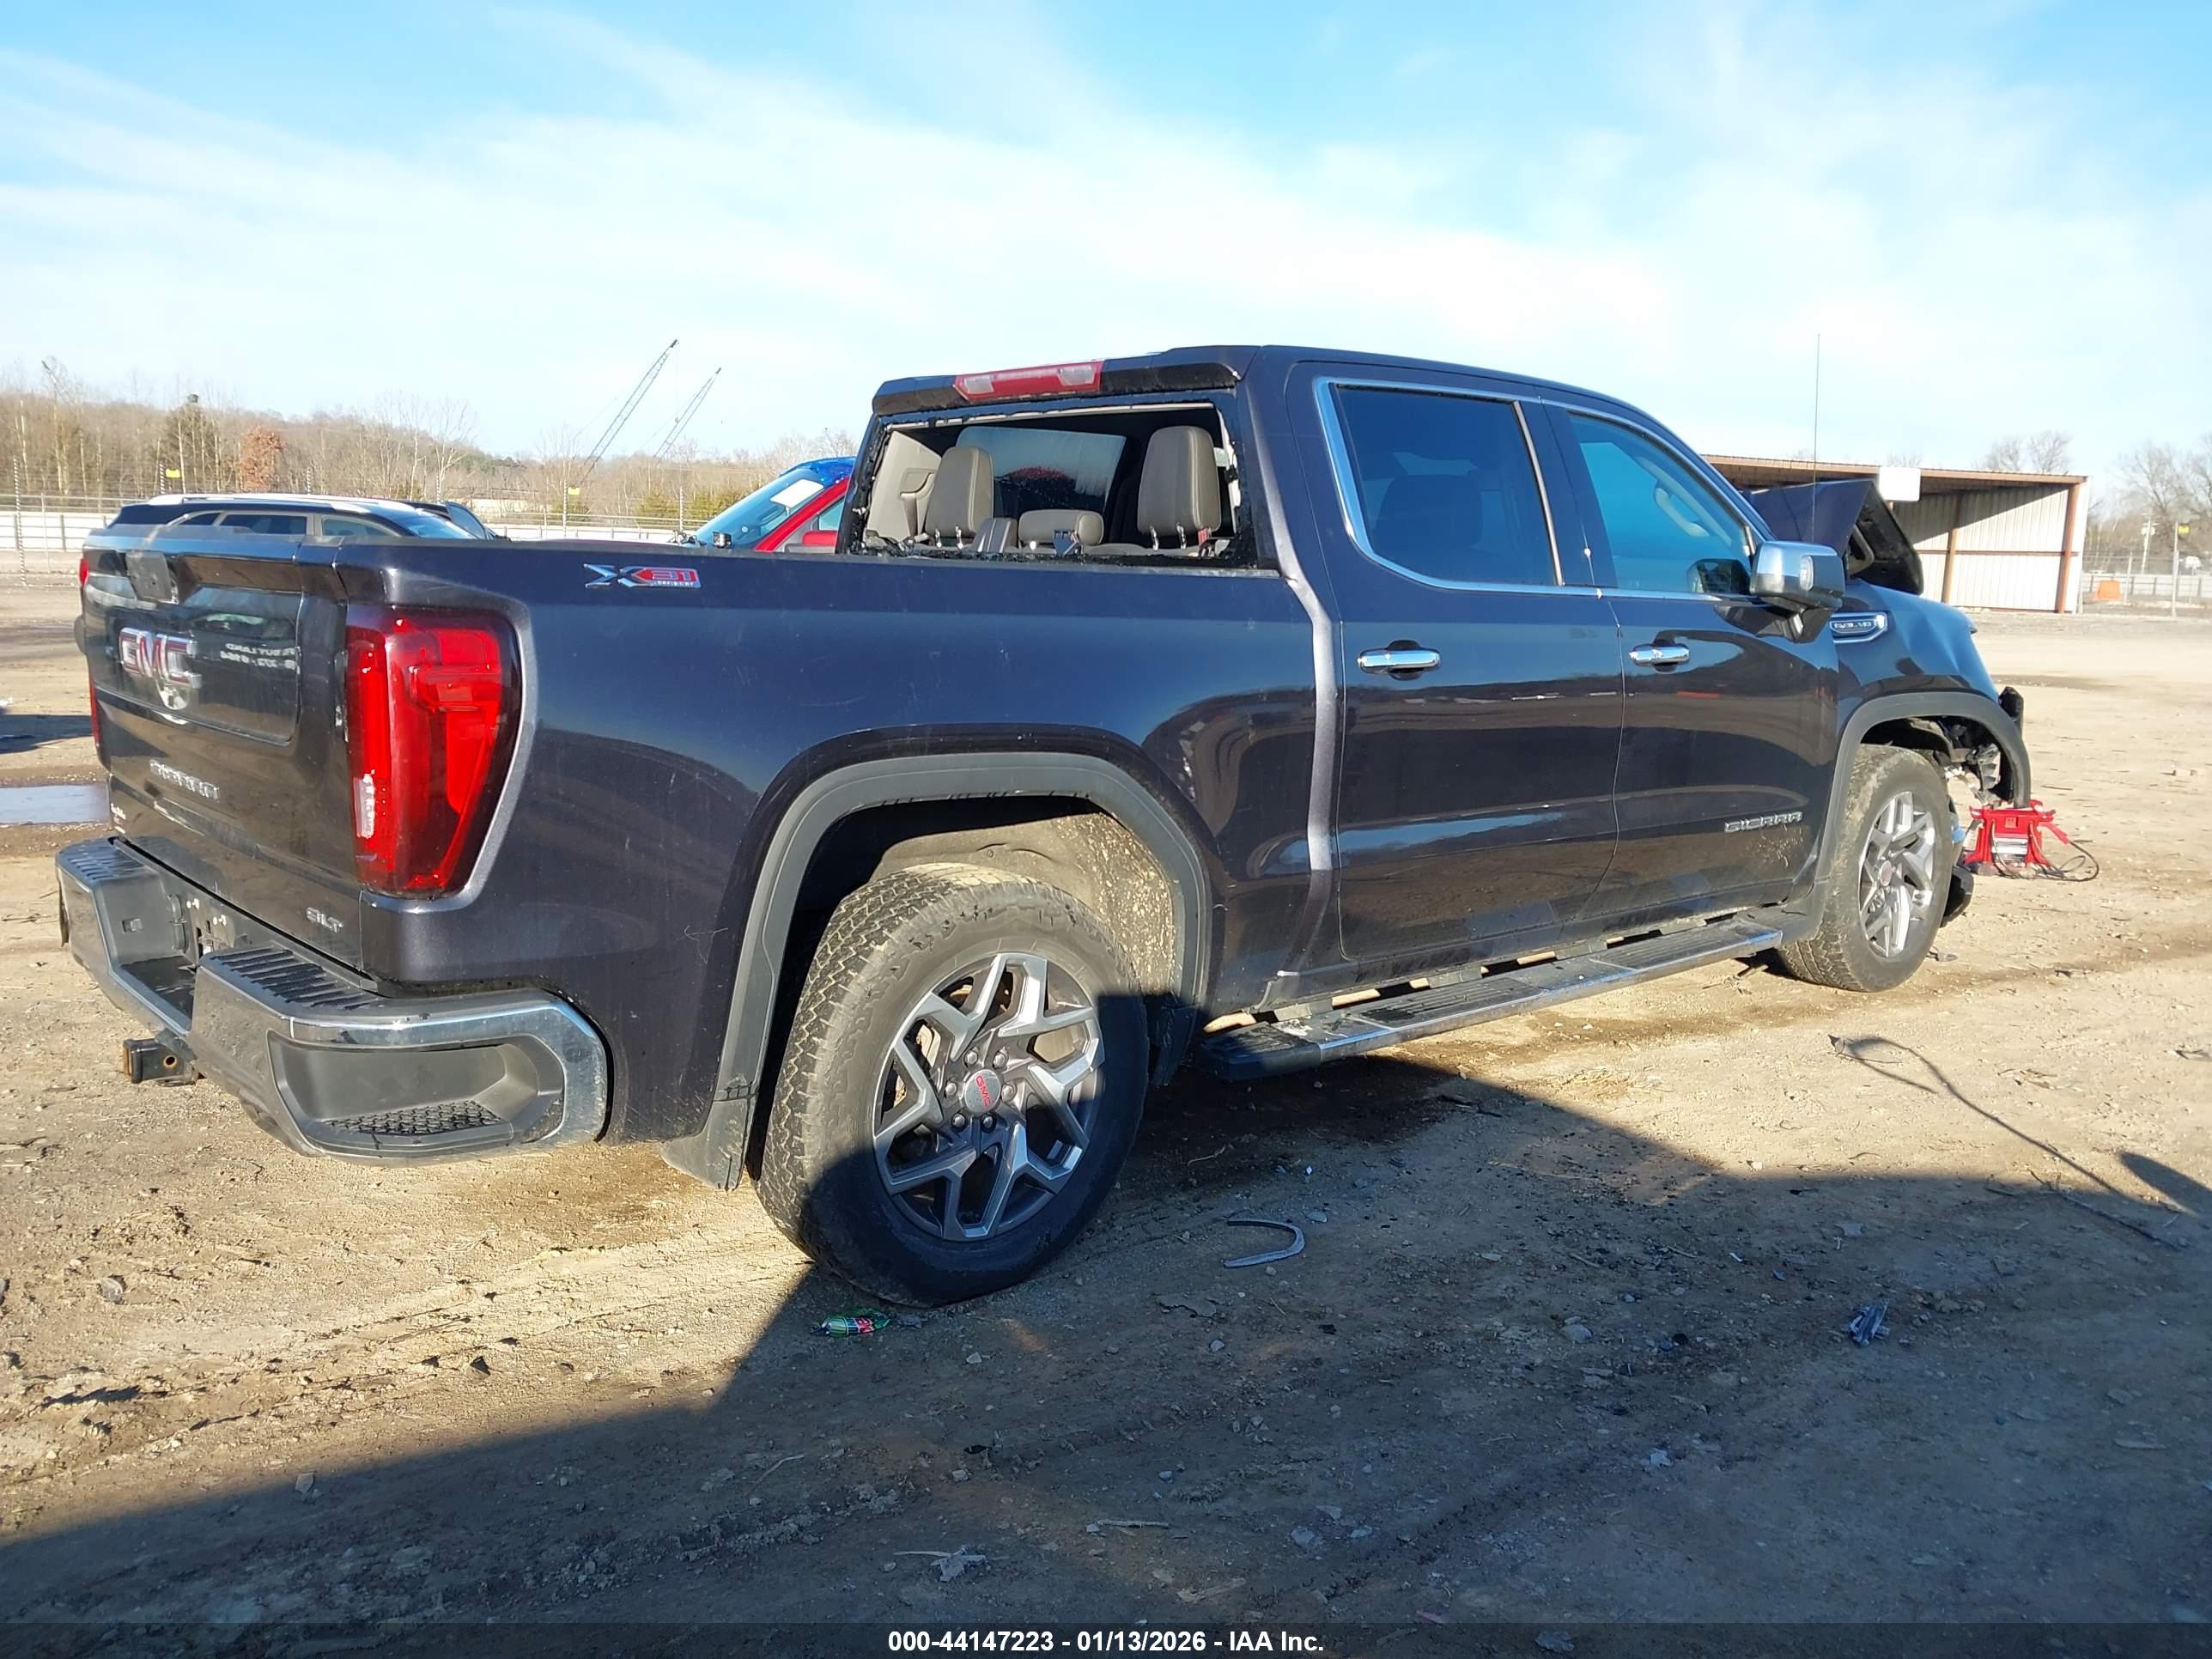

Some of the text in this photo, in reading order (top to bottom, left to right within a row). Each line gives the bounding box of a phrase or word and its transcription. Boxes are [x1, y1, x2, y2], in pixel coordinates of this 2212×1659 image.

[119, 627, 202, 689] GMC
[1724, 811, 1803, 833] SIERRA
[306, 907, 344, 933] SLT
[975, 1074, 992, 1109] GMC
